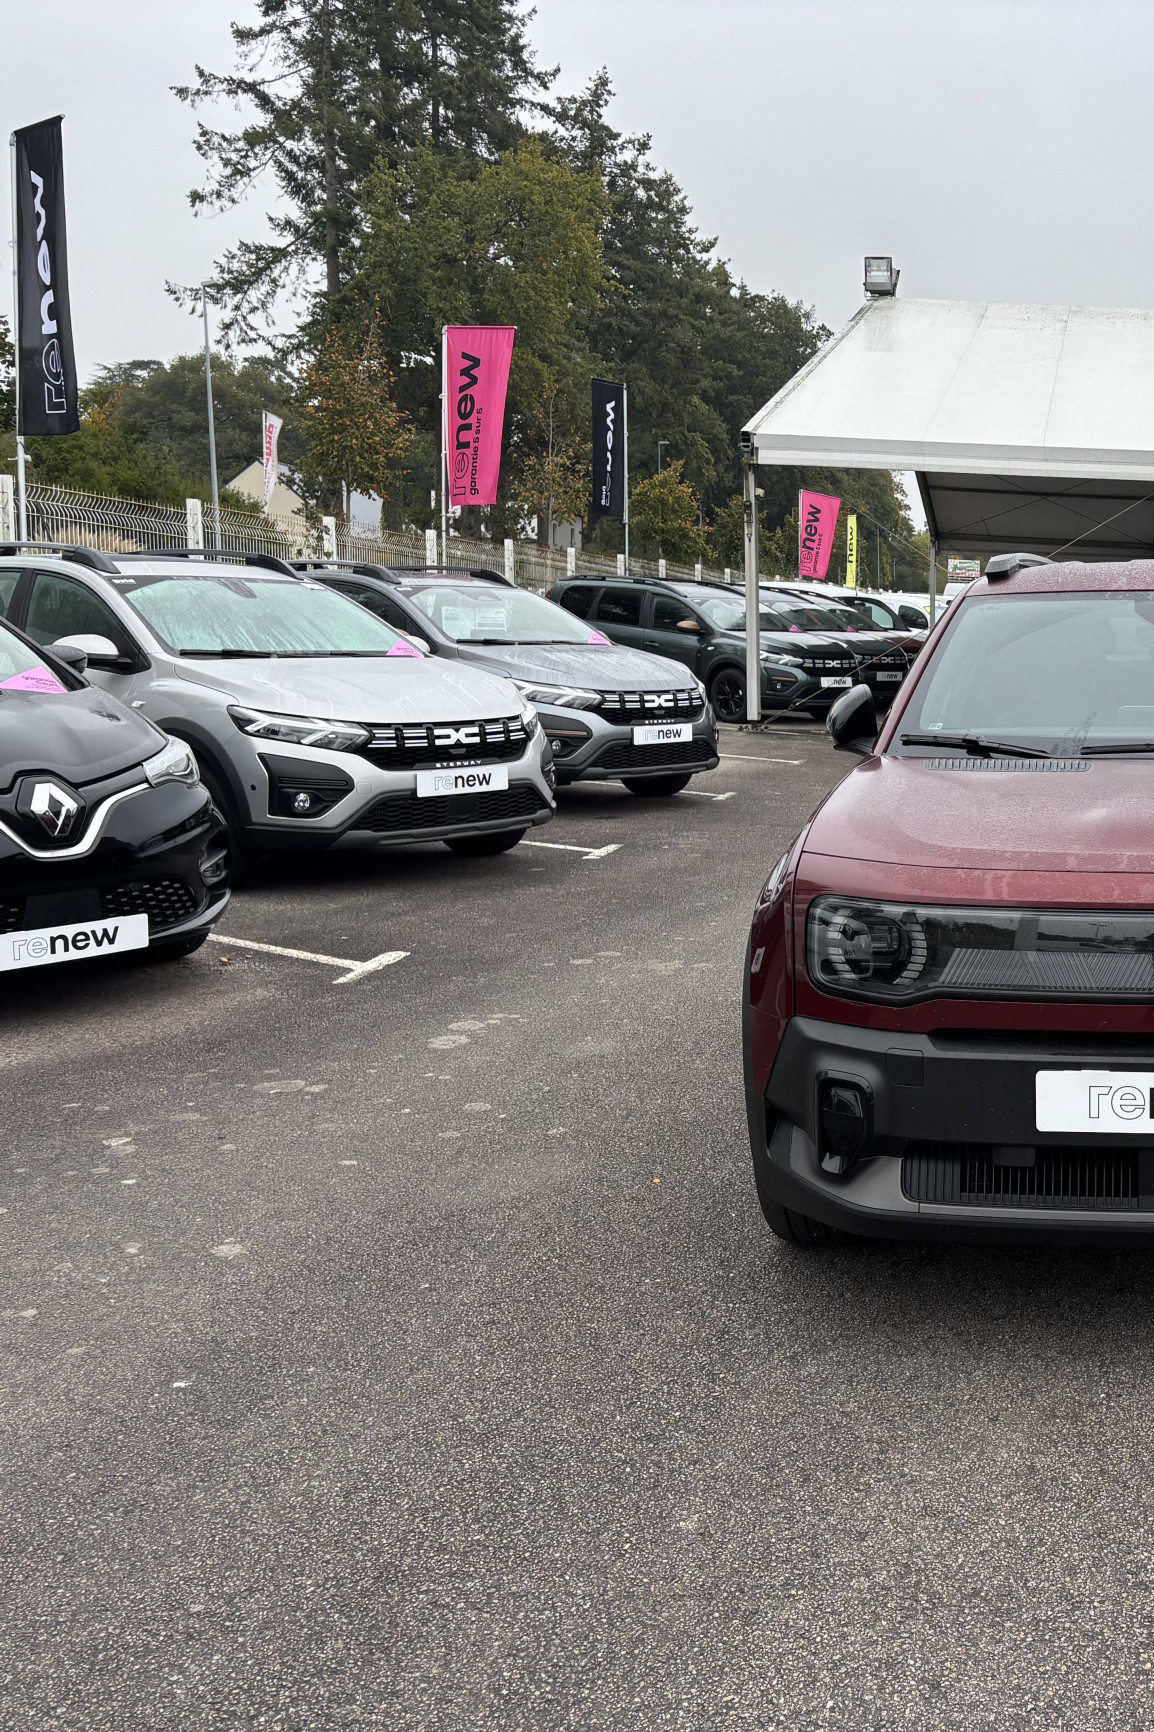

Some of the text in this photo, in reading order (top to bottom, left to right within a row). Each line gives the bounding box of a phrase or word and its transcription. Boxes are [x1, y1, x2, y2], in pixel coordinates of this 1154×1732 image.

[30, 170, 66, 414] renew
[453, 351, 481, 496] renew
[470, 446, 479, 495] garantie
[800, 503, 821, 572] renew
[645, 728, 682, 740] renew
[434, 773, 492, 791] renew
[436, 760, 481, 768] STEPWAY
[13, 925, 119, 961] renew
